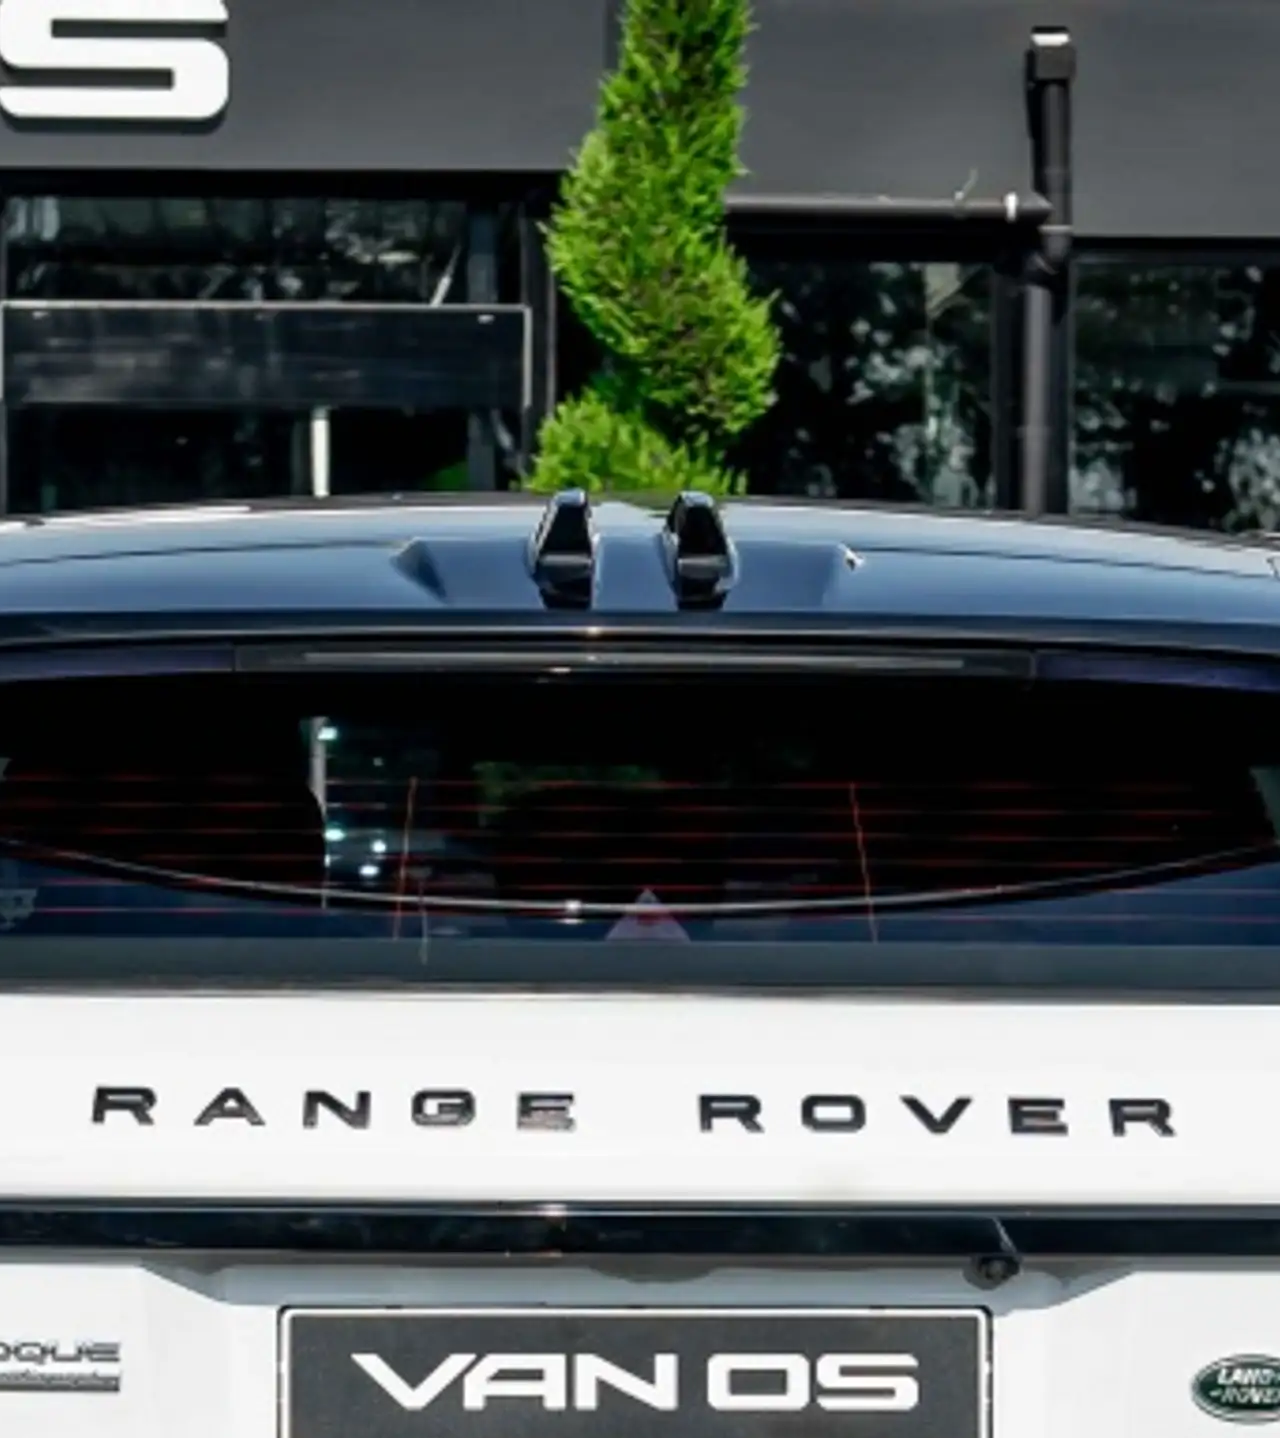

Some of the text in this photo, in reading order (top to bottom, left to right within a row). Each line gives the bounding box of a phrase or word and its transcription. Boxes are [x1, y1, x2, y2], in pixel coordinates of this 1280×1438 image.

[91, 1086, 1176, 1138] RANGE ROVER
[350, 1352, 920, 1412] VAN OS
